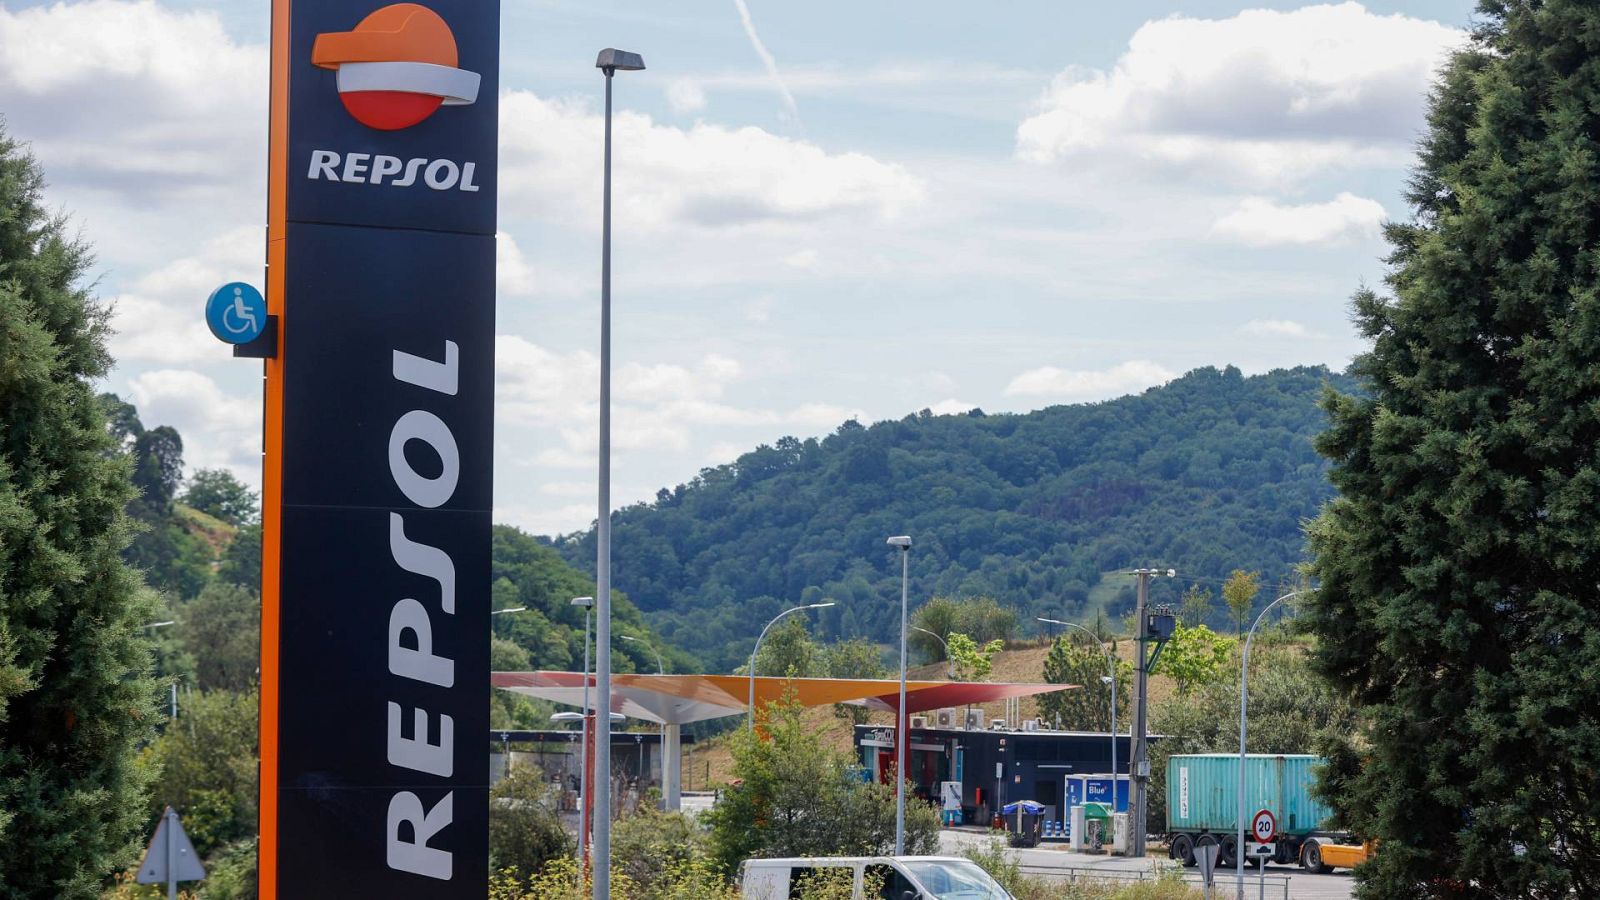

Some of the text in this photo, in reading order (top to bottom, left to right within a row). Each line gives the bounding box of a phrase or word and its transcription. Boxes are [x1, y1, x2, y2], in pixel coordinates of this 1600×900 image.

[307, 150, 479, 192] REPSOL
[386, 339, 460, 881] REPSOL
[1258, 821, 1271, 832] 20
